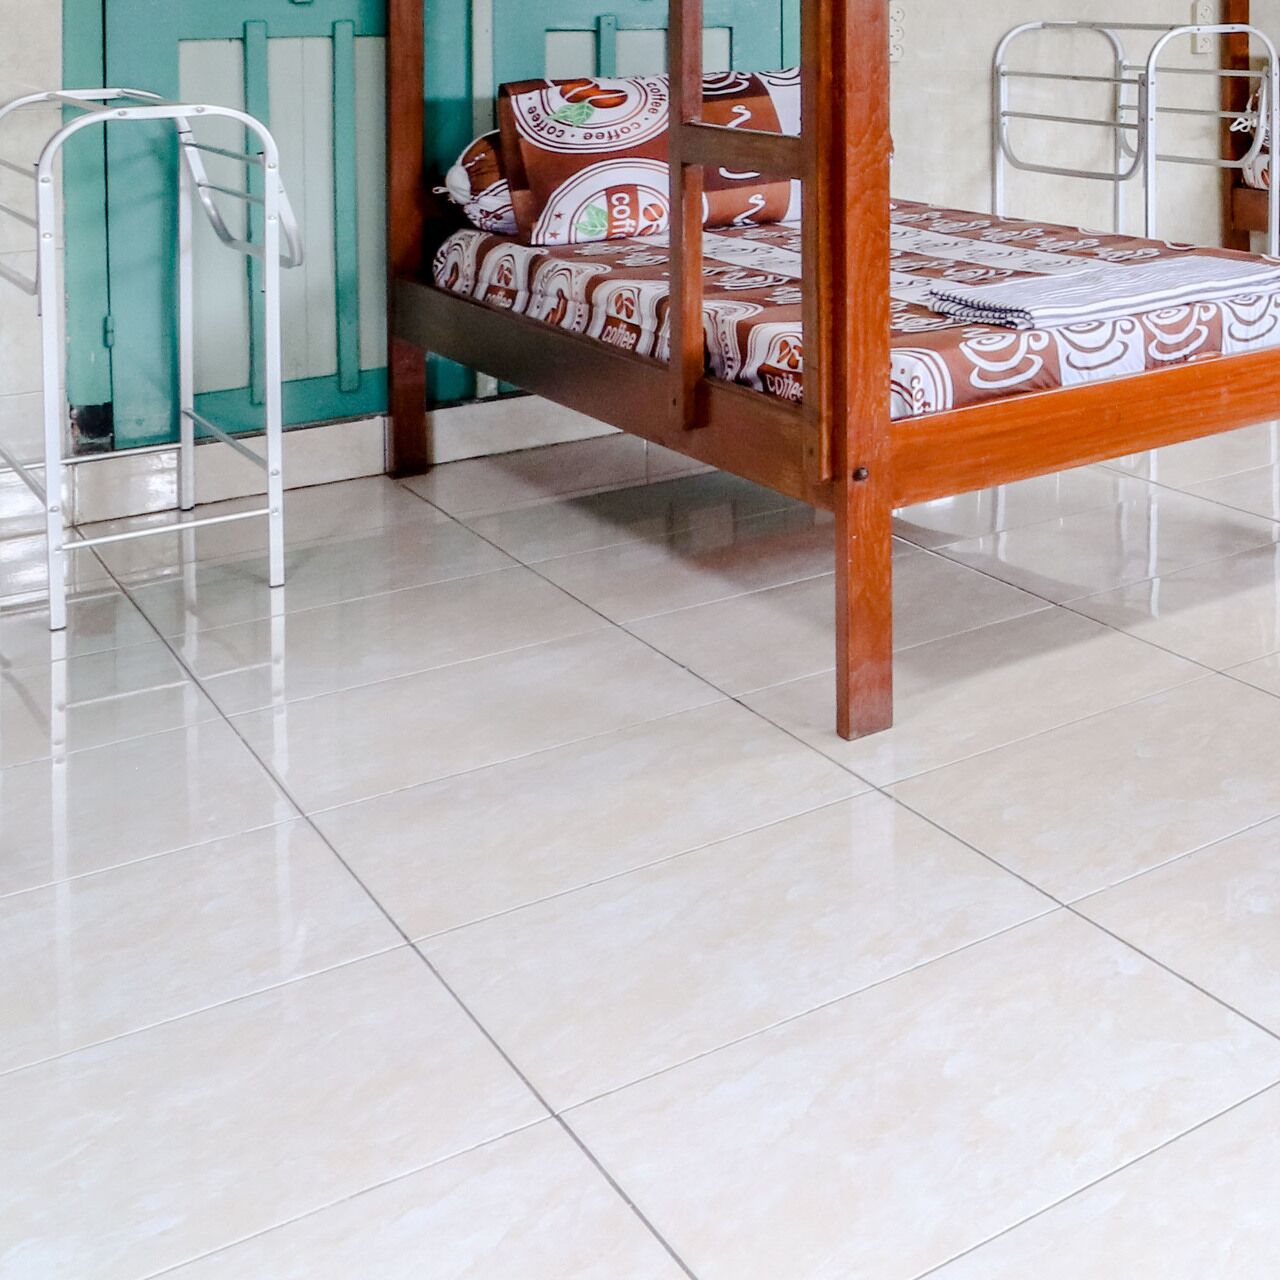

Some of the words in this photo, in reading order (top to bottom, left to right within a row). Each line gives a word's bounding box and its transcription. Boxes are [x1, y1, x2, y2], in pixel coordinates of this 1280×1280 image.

[645, 81, 667, 115] coffee
[527, 106, 566, 139] coffee
[583, 121, 641, 141] coffee
[611, 192, 636, 238] coff
[601, 321, 637, 350] coffee
